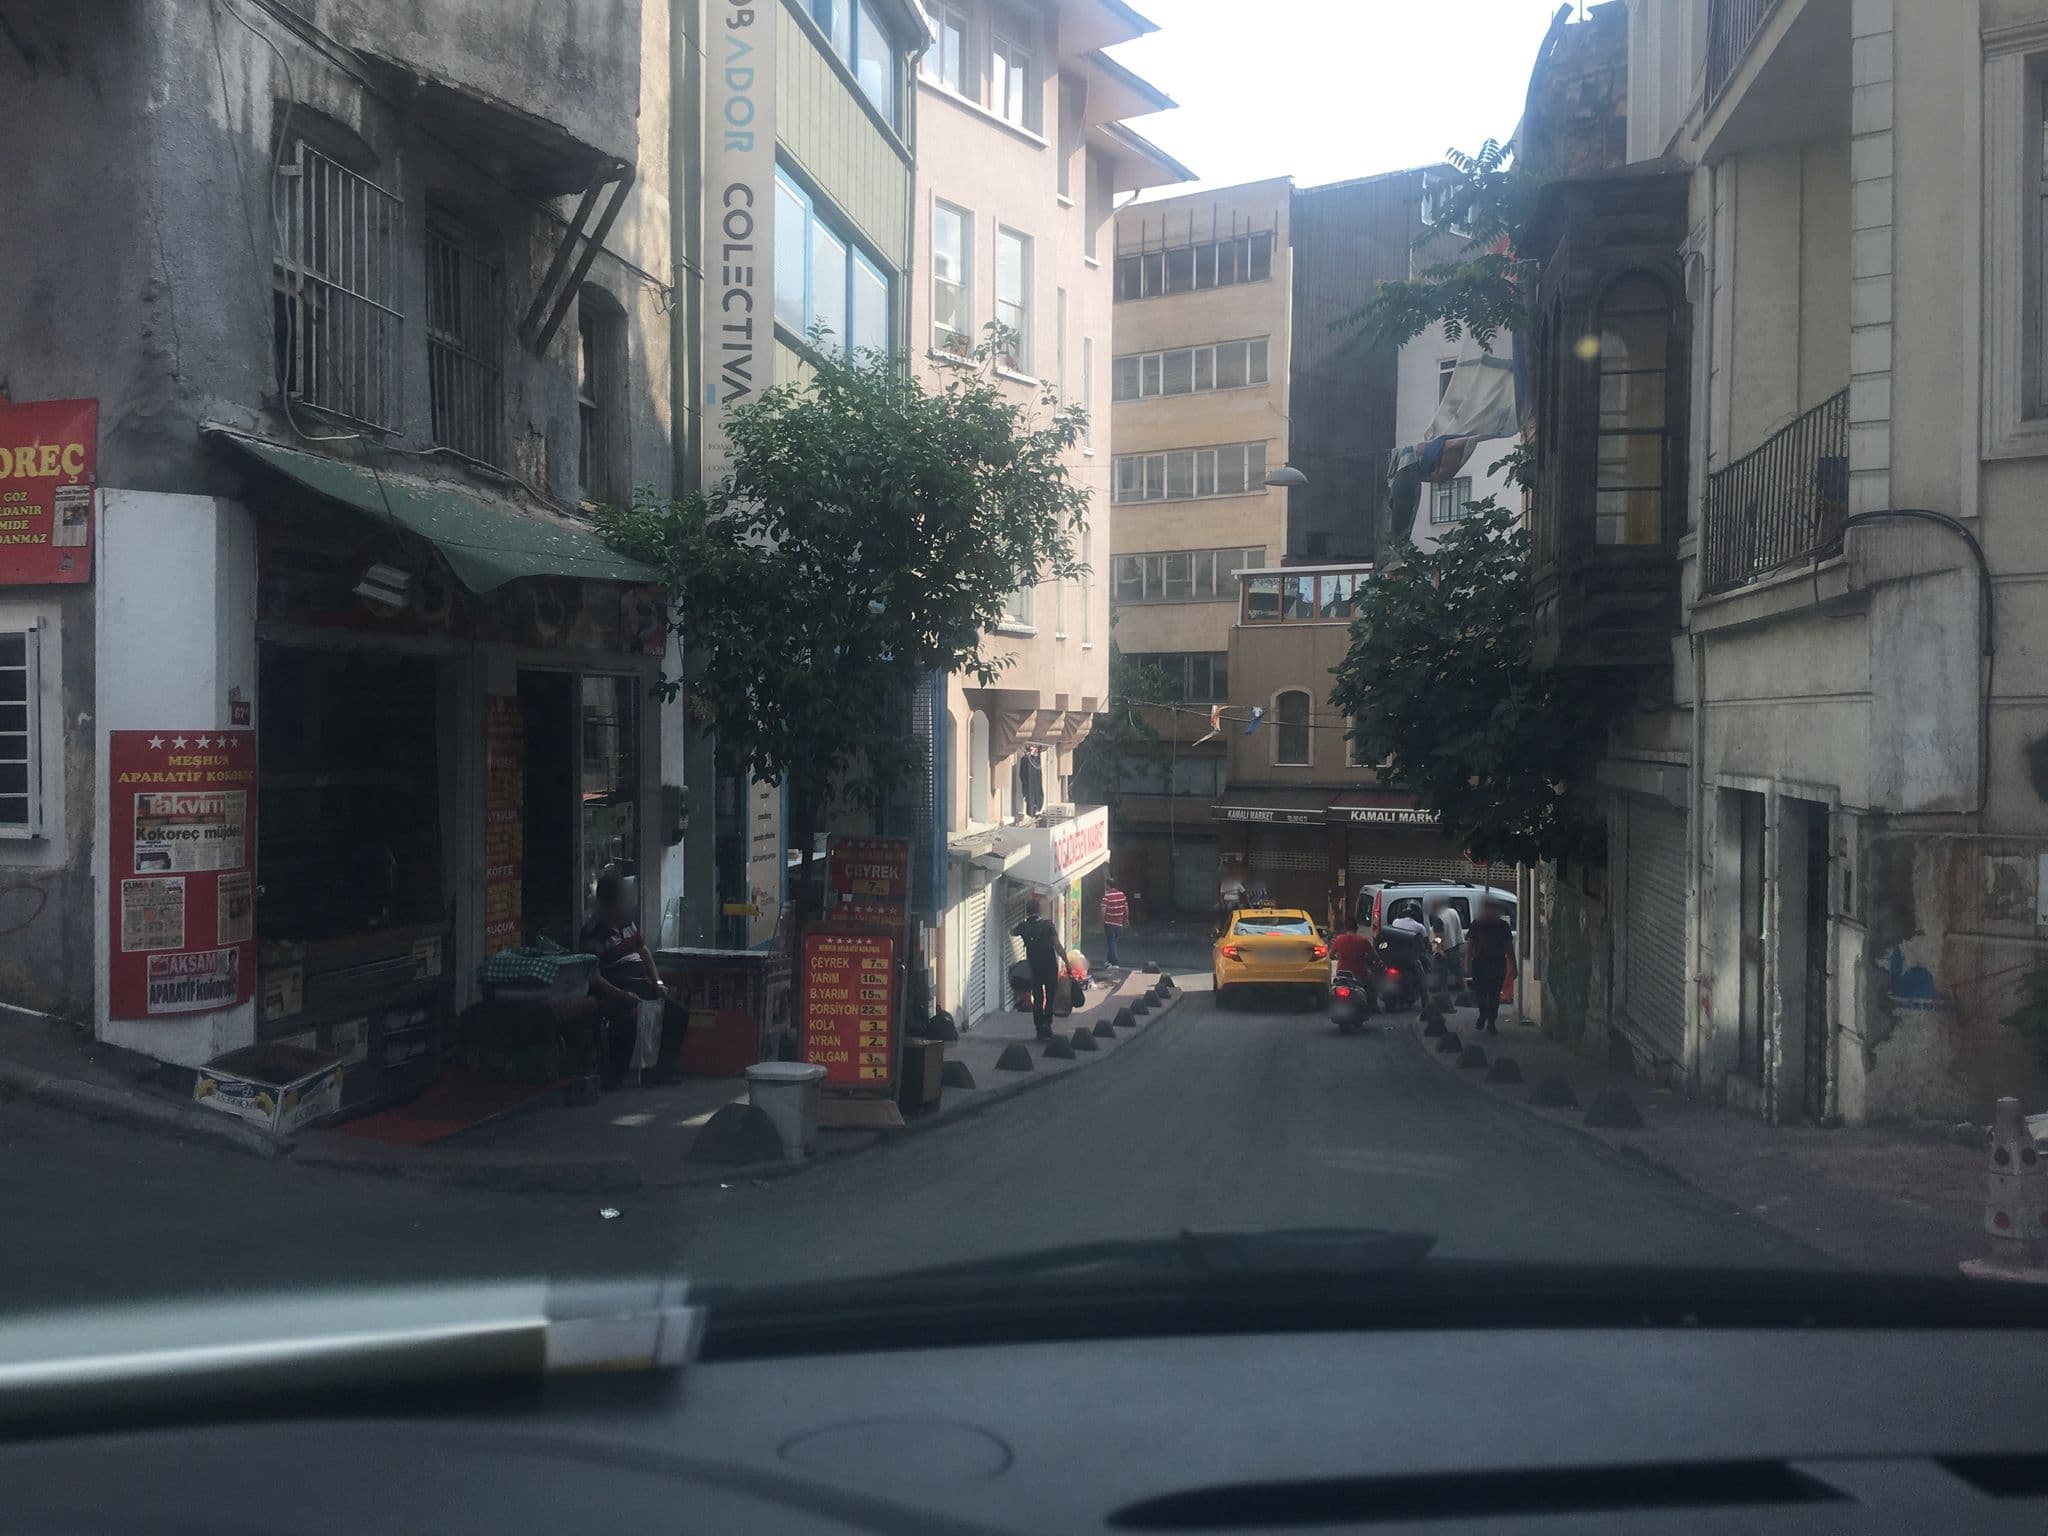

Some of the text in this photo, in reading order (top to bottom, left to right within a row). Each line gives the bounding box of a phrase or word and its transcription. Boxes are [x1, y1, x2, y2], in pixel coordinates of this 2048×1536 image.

[721, 182, 755, 403] COLECTIVA
[1350, 810, 1396, 822] KAMALI
[136, 827, 200, 842] Kokoreç
[810, 957, 850, 971] ÇEYREK
[810, 972, 840, 984] YARIM
[809, 1002, 860, 1015] PORSİYON
[809, 1020, 836, 1031] KOLA
[808, 1035, 841, 1047] AYRAN
